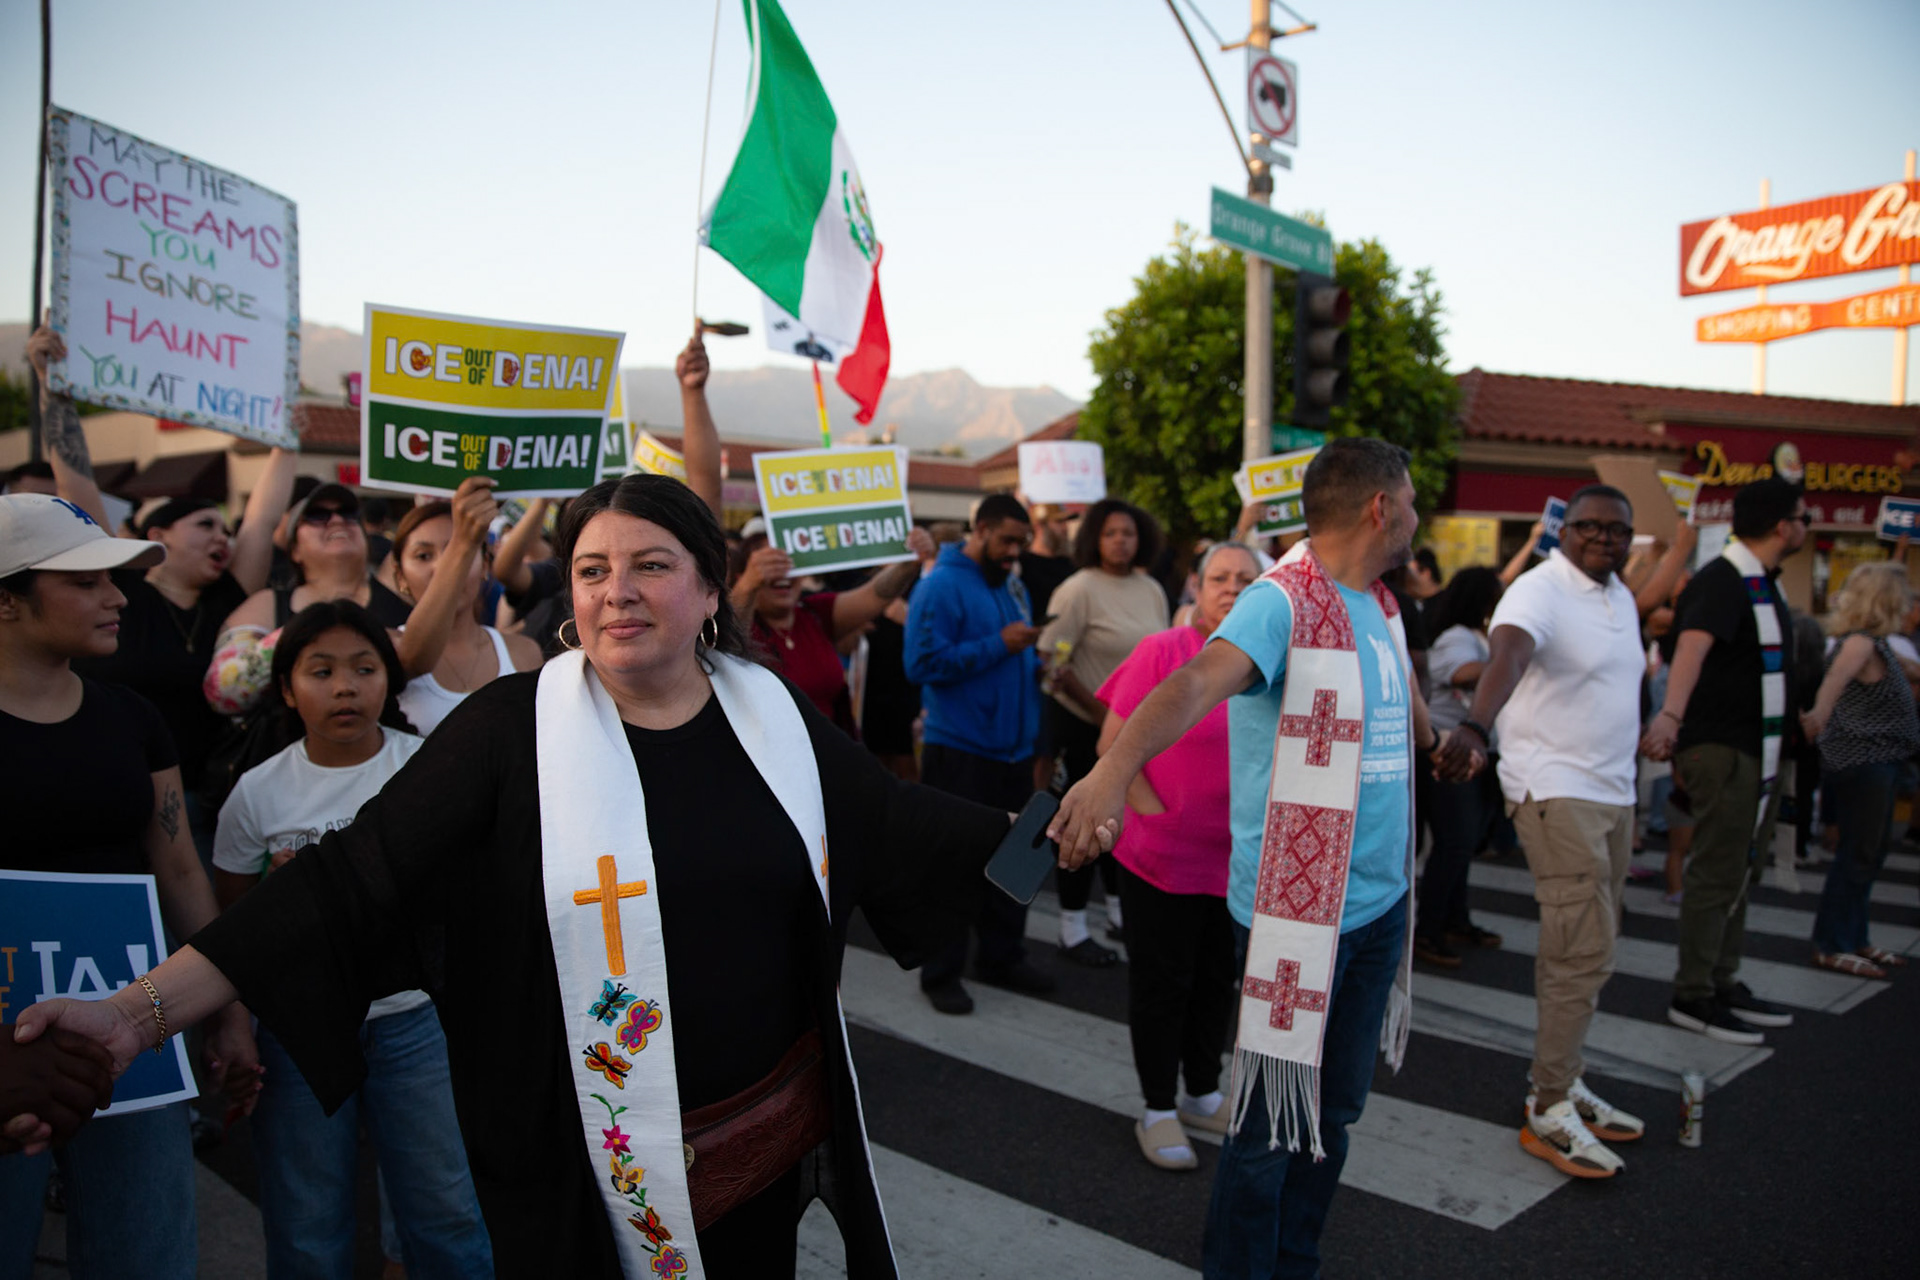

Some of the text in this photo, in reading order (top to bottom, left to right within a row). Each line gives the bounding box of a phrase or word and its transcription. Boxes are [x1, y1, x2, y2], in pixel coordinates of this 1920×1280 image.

[88, 126, 241, 207] MAY THE
[68, 155, 283, 270] SCREAMS
[138, 220, 218, 271] YOU
[1685, 214, 1846, 289] Orange
[103, 248, 261, 322] IGNORE
[105, 300, 250, 369] HAUNT
[1703, 290, 1920, 341] SHOPPING CENT
[384, 336, 605, 391] ICE DENA!
[464, 347, 494, 367] OUT
[467, 366, 487, 386] OF
[78, 344, 283, 430] YOU AT NIGHT!
[383, 422, 460, 469] ICE
[488, 434, 593, 471] DENA!
[460, 434, 488, 453] OUT
[463, 452, 482, 471] OF
[1694, 440, 1903, 493] Dena BURGERS
[768, 470, 815, 499] ICE
[825, 464, 895, 493] DENA!
[1252, 467, 1285, 491] ICE
[781, 524, 828, 555] ICE
[837, 516, 906, 548] DENA!
[1266, 501, 1292, 524] CE
